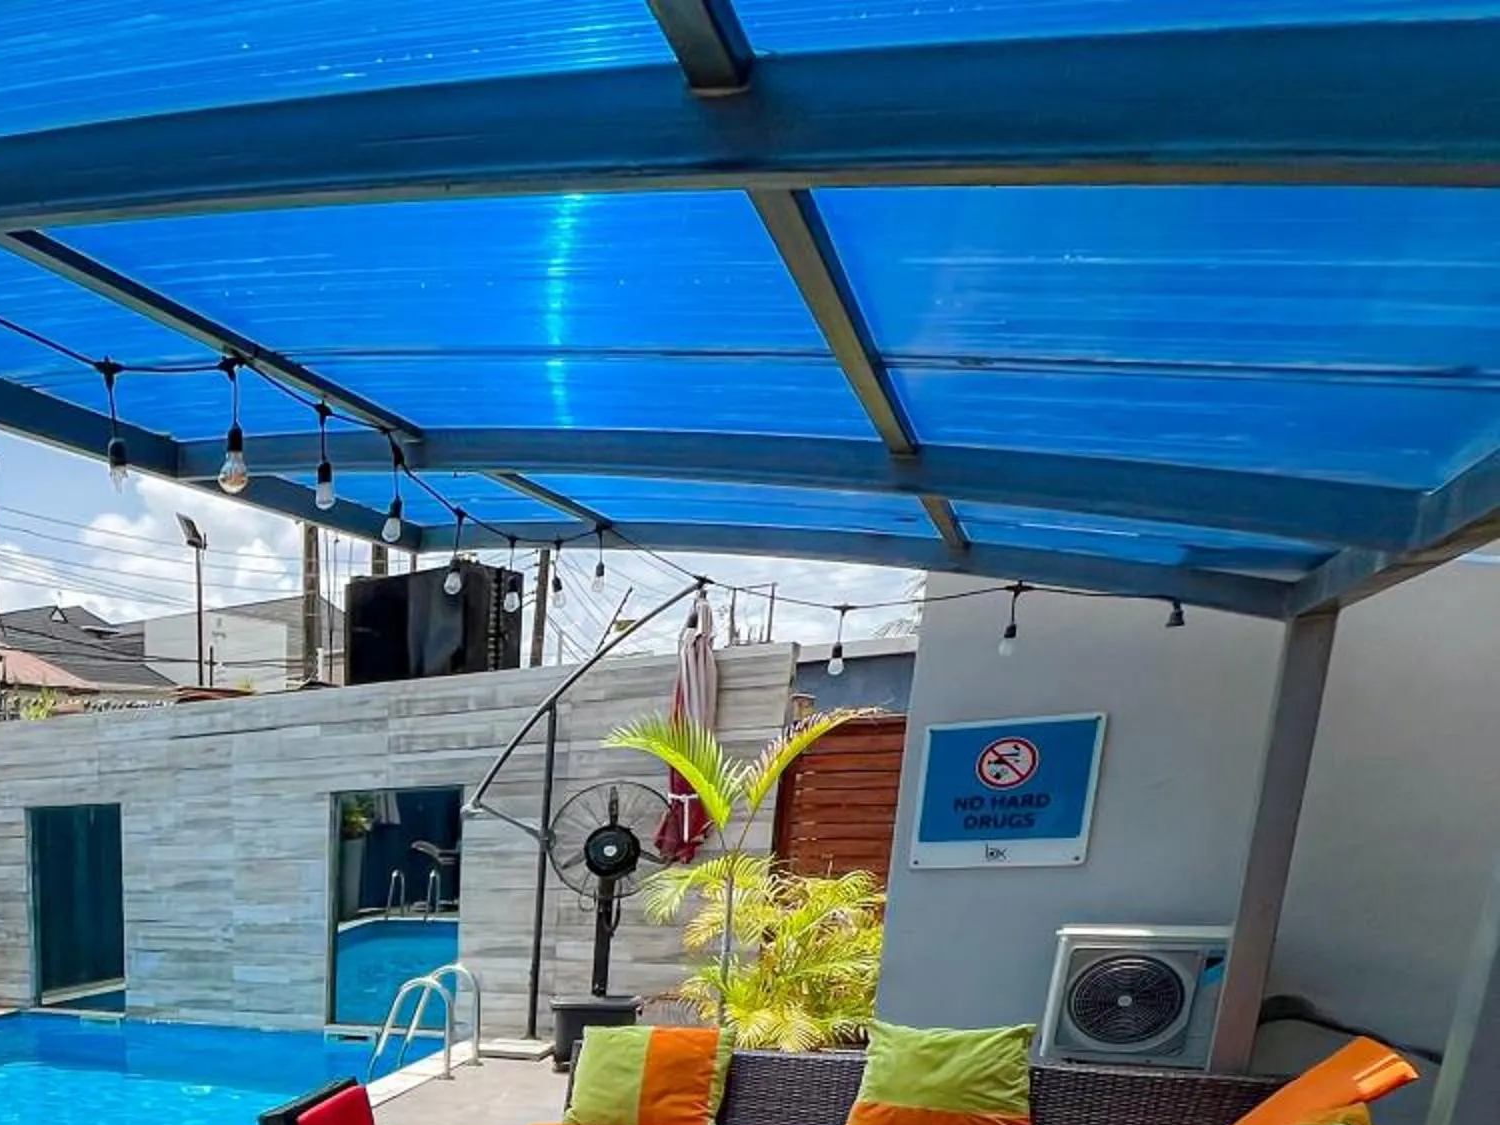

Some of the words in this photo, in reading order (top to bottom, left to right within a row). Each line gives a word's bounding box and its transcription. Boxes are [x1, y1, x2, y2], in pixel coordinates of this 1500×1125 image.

[954, 796, 985, 812] NO
[990, 793, 1051, 810] HARD
[963, 814, 1035, 830] DRUGS
